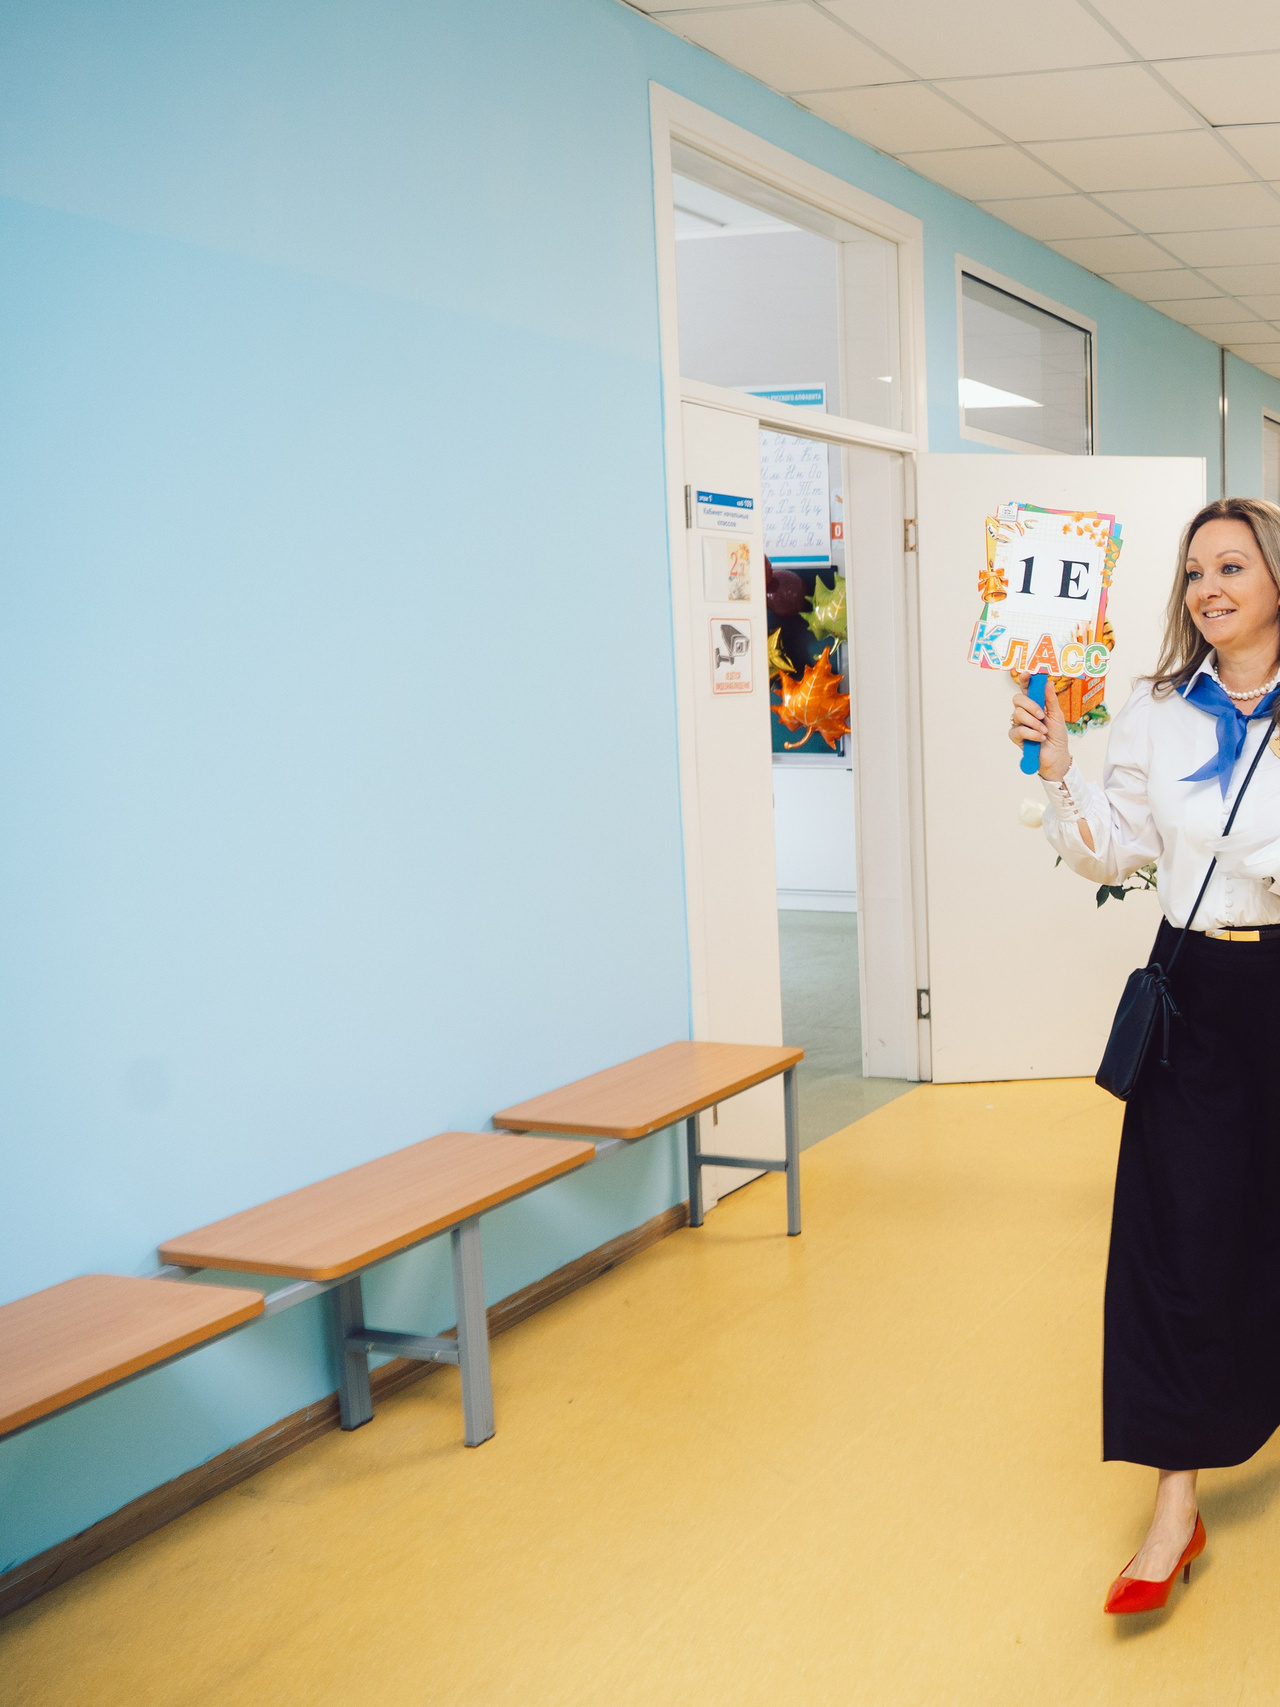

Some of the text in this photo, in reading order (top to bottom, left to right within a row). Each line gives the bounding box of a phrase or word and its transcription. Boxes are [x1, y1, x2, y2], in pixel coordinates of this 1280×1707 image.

[730, 550, 738, 576] 2
[1015, 555, 1090, 601] 1 Е
